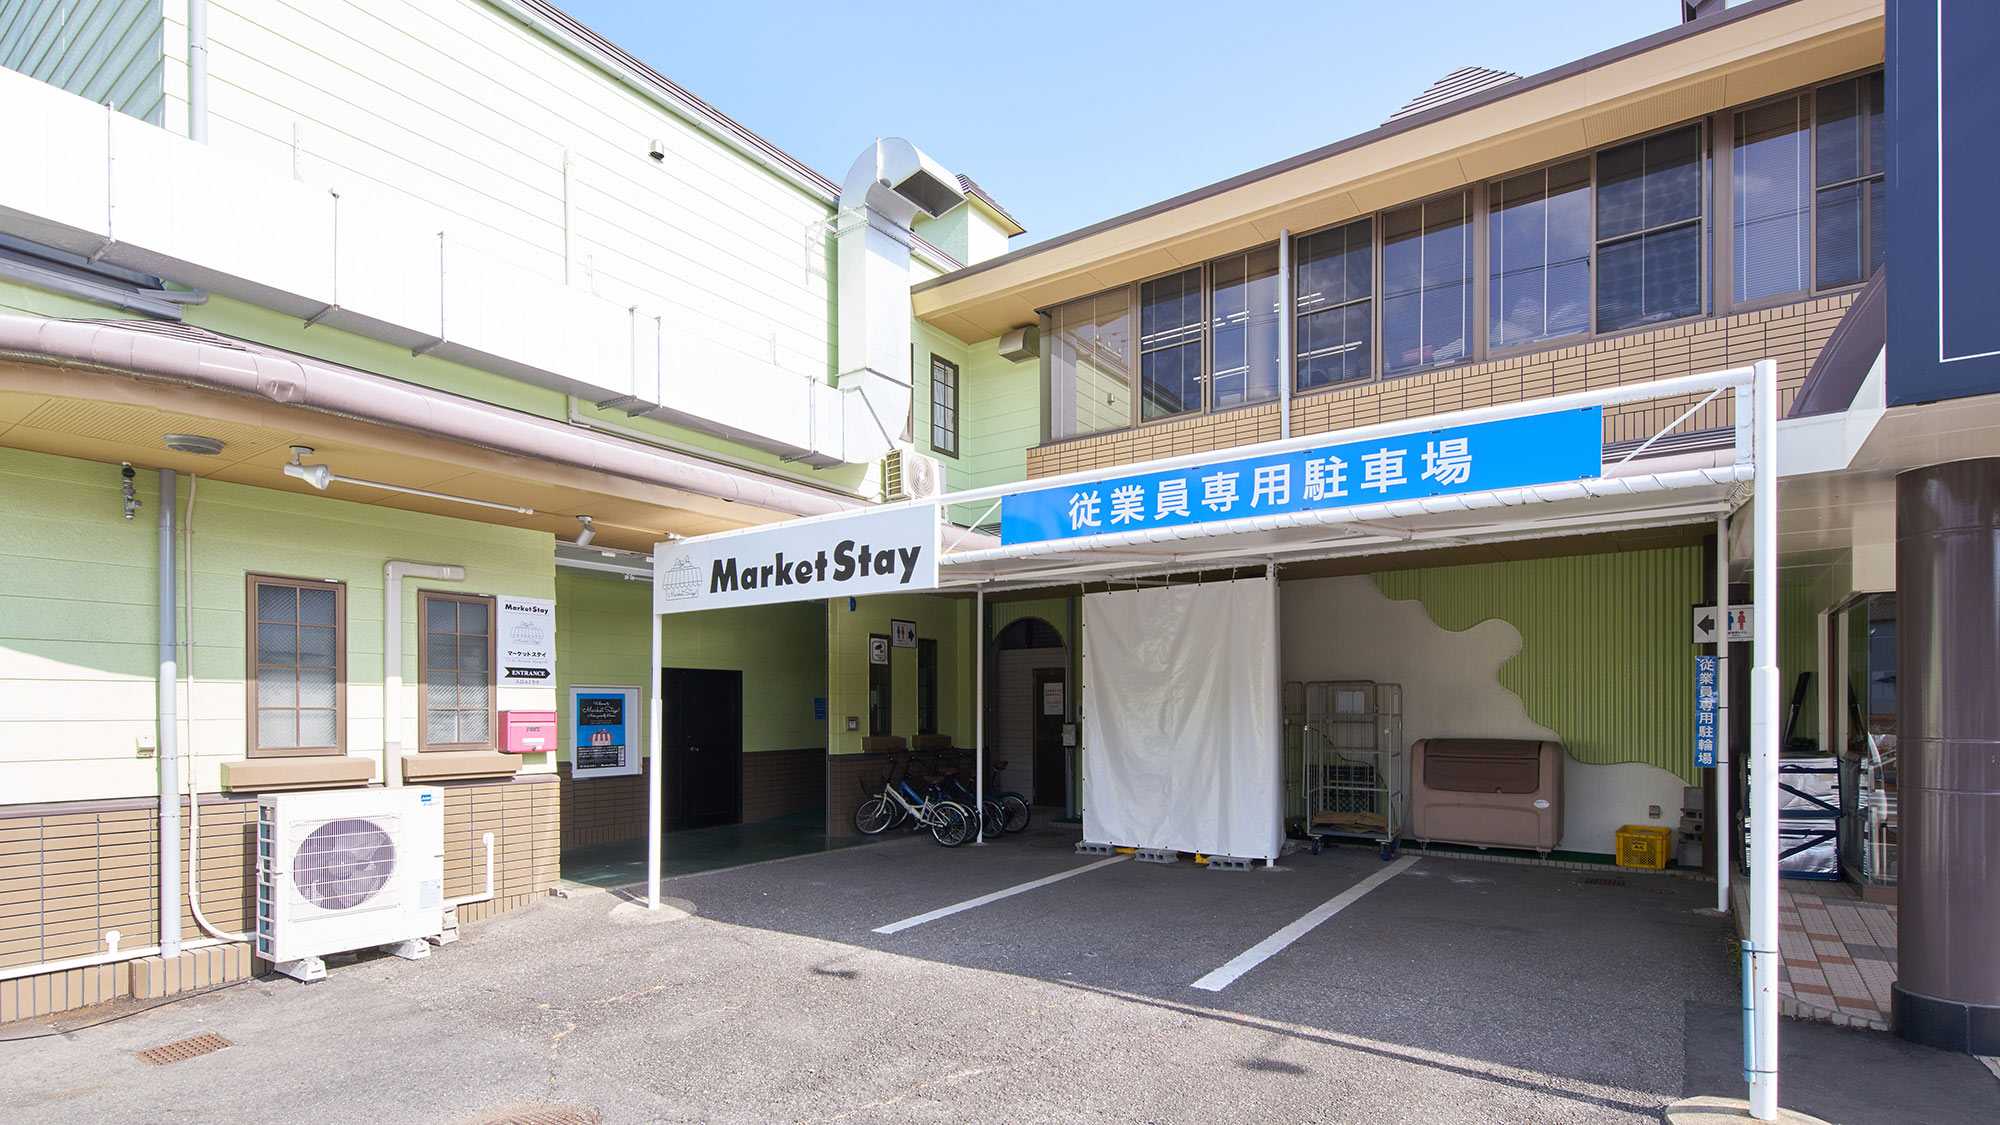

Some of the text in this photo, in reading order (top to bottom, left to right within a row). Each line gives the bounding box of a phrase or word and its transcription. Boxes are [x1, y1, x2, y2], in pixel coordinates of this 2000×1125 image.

[1068, 437, 1473, 531] 従業員専用駐車場
[507, 650, 547, 658] マーケットステイ
[1698, 658, 1715, 765] 従業員専用駐輪場
